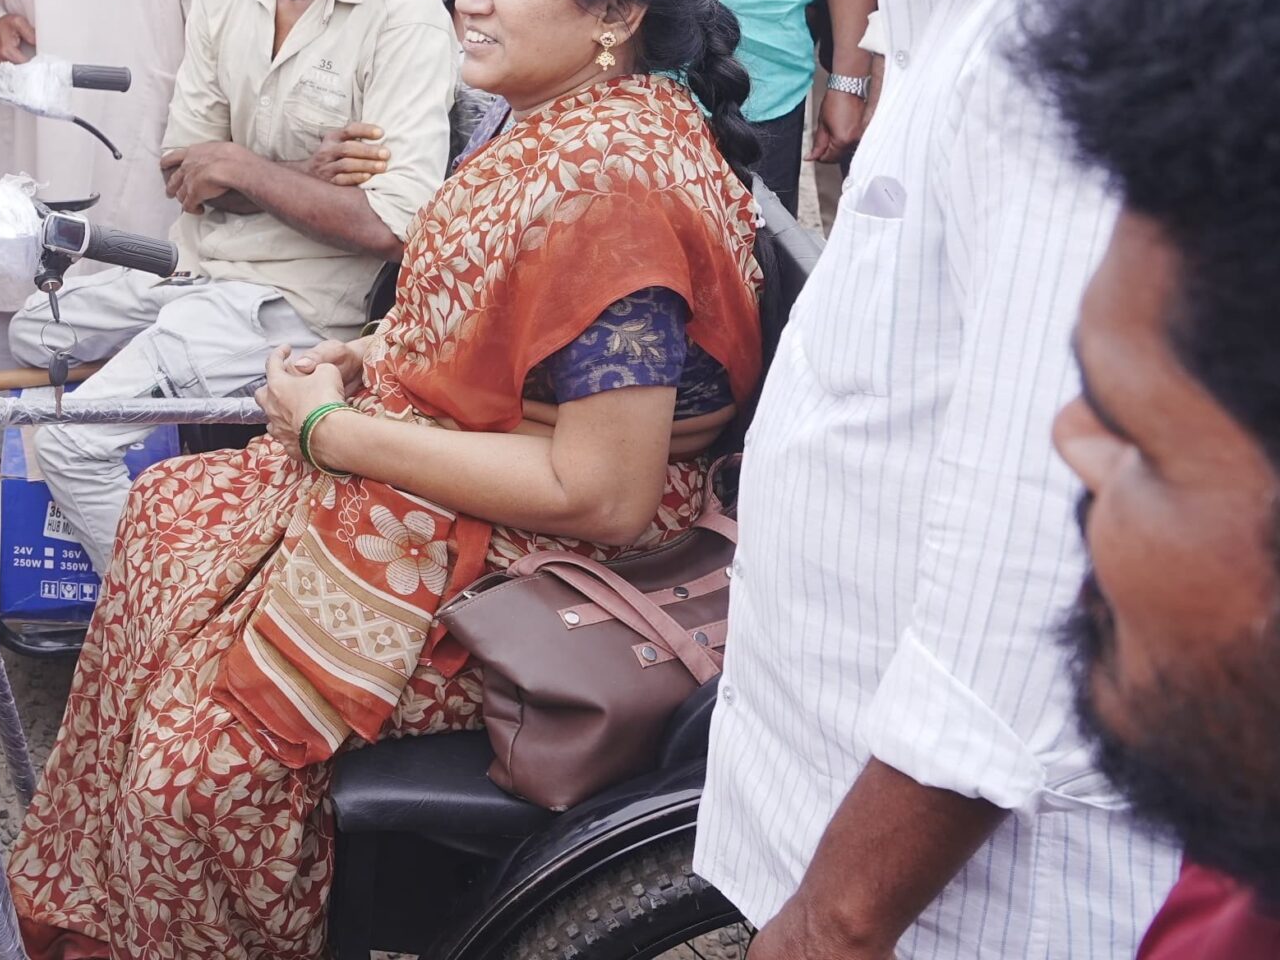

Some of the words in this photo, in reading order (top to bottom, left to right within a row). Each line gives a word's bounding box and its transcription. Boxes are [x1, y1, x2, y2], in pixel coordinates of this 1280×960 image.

[319, 58, 333, 70] 35
[47, 520, 61, 532] HUB
[13, 546, 33, 555] 24V
[62, 549, 81, 559] 36V
[13, 558, 42, 568] 250W
[60, 561, 88, 571] 350W
